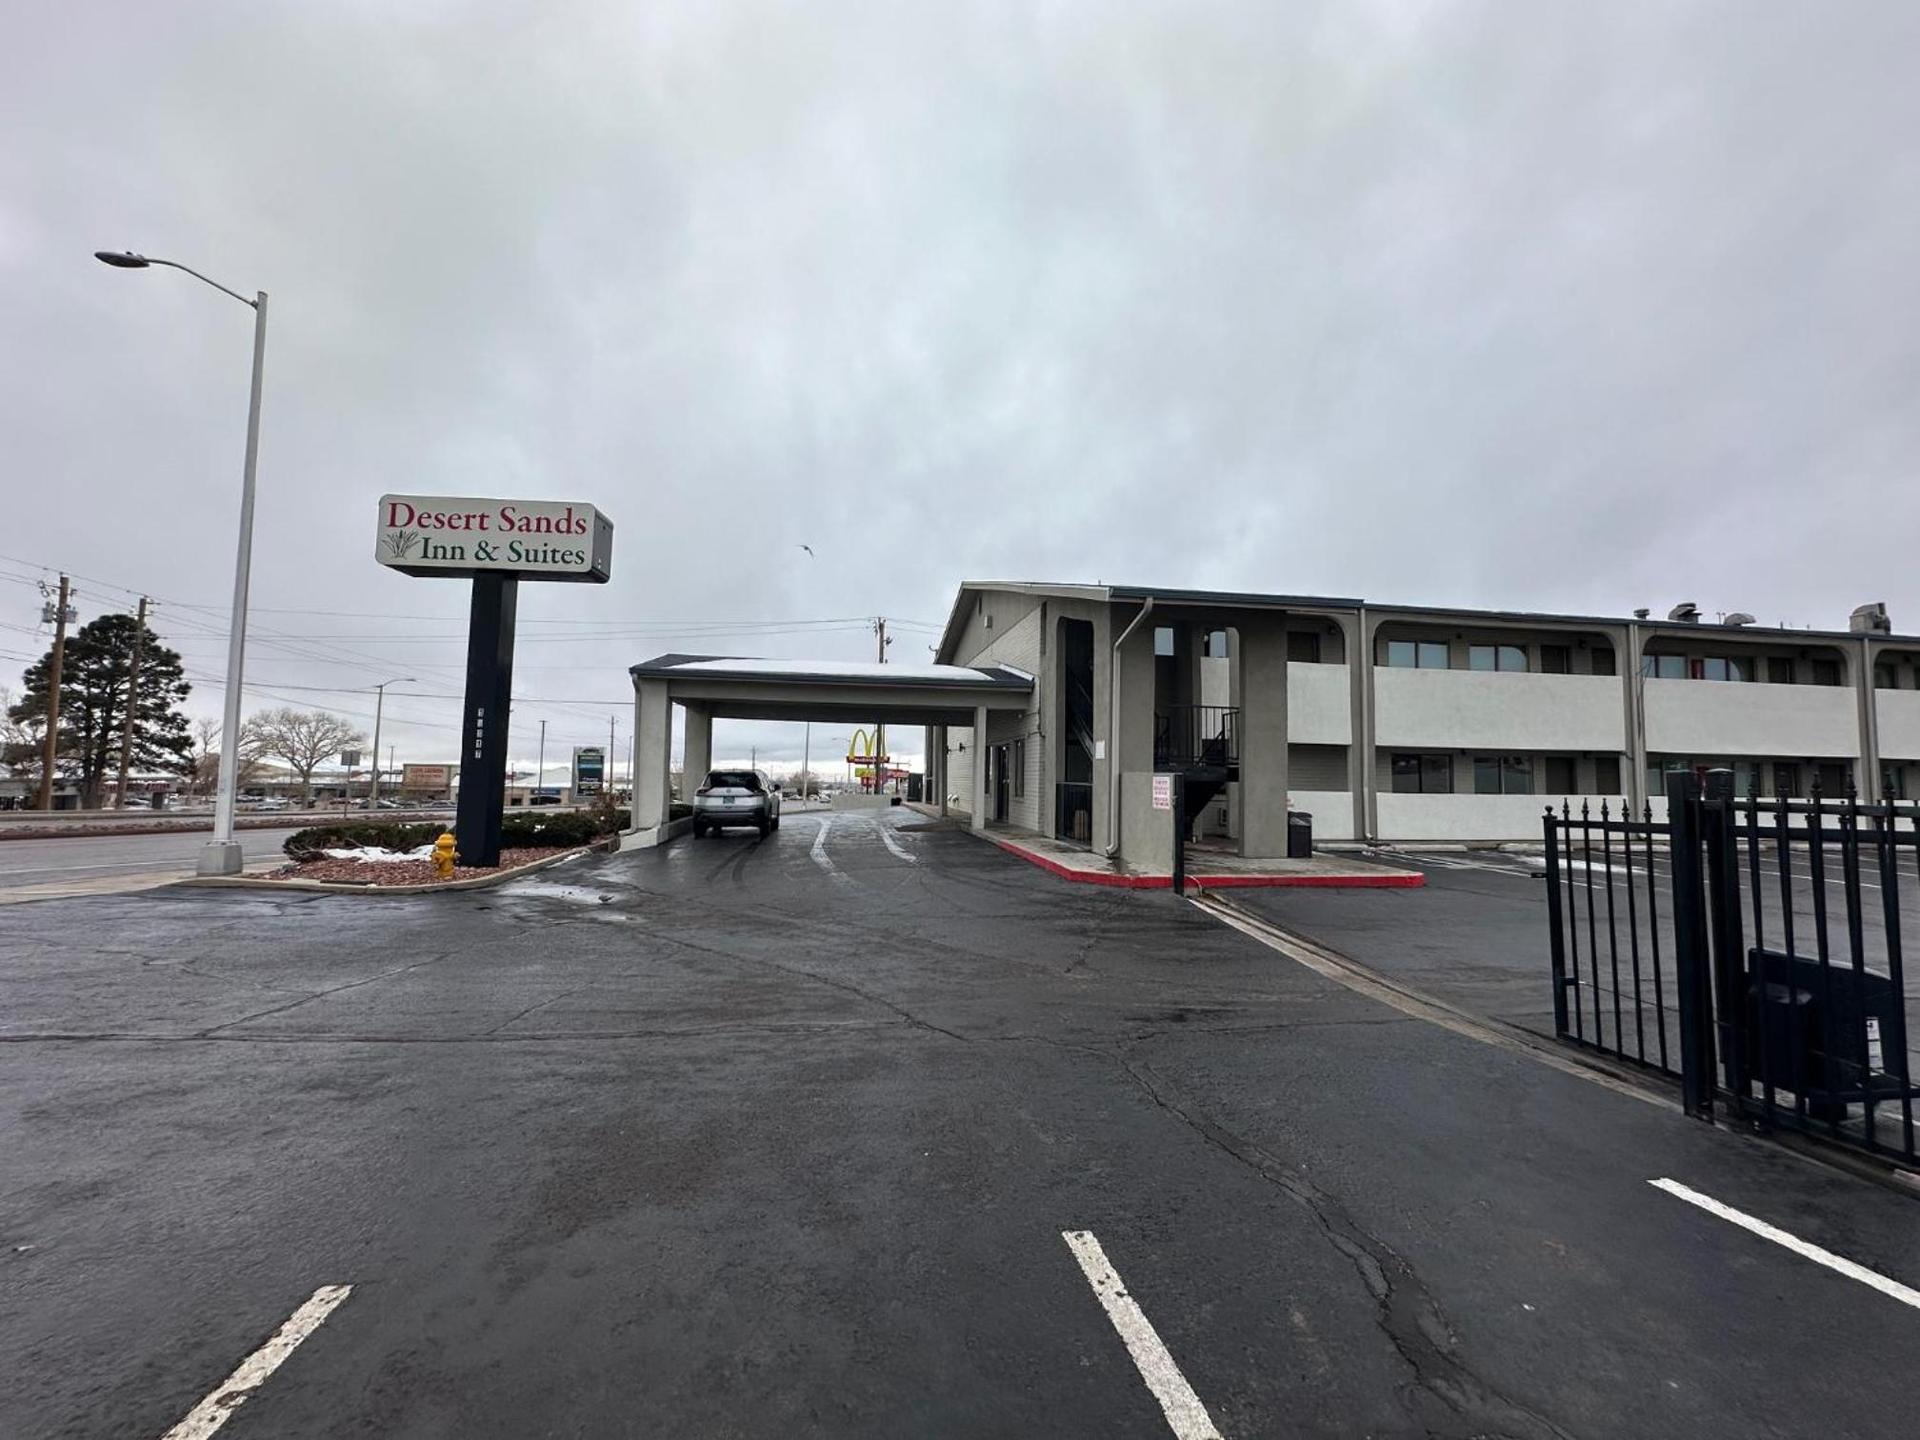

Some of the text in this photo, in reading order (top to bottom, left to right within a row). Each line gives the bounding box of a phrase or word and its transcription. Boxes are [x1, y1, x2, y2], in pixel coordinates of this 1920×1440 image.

[386, 502, 587, 535] Desert Sands
[420, 536, 585, 565] Inn & Suites
